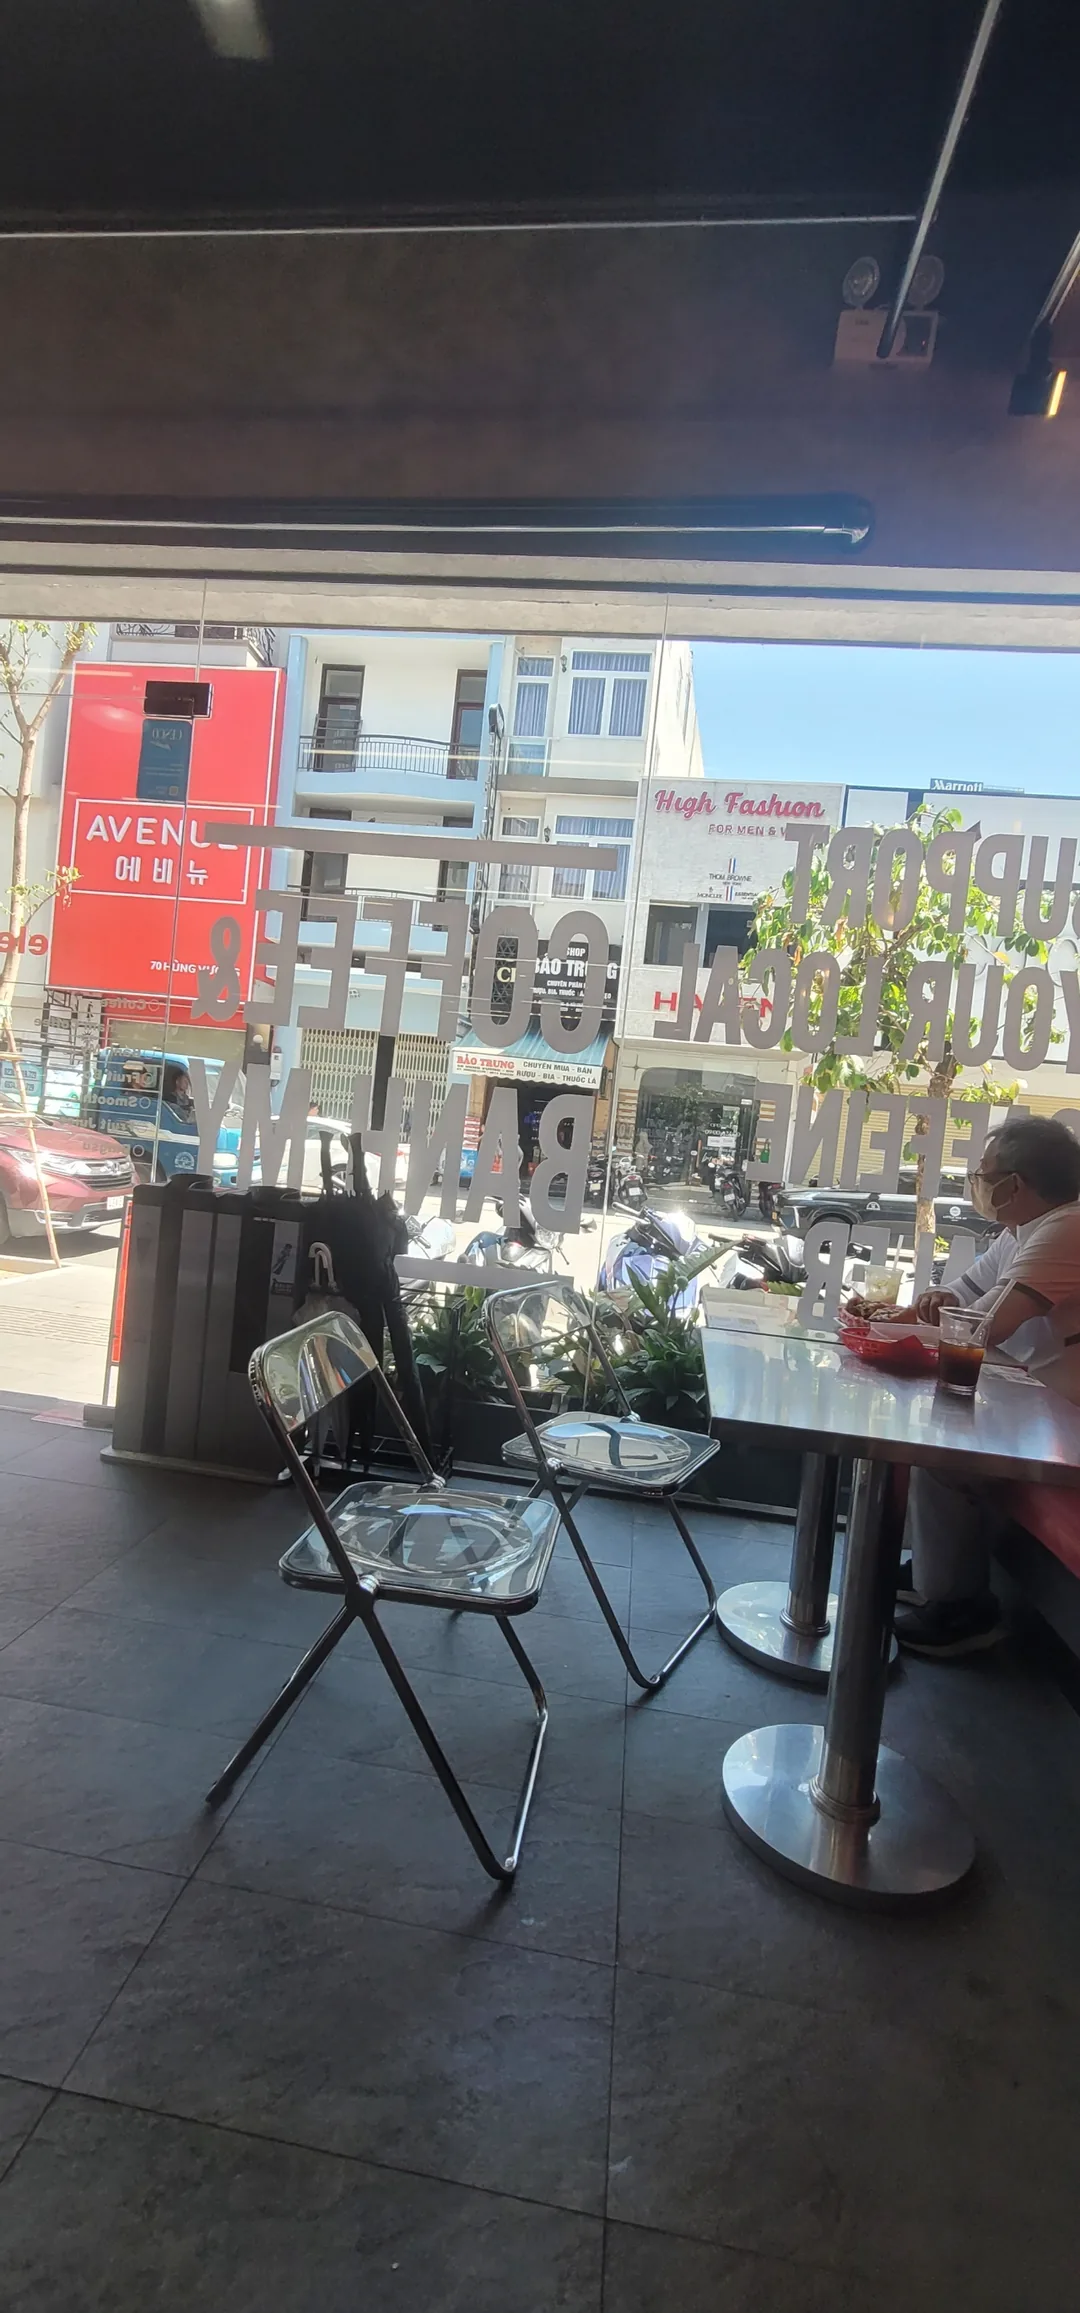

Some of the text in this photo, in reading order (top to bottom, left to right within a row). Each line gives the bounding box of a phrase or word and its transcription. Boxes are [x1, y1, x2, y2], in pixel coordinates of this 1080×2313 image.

[933, 780, 982, 791] Marriott
[655, 790, 825, 820] High Fashion
[86, 815, 238, 850] AVENU
[709, 824, 733, 835] FOR
[737, 826, 764, 836] MEN
[768, 826, 777, 836] &
[150, 961, 162, 970] 70
[567, 959, 618, 980] TRG
[480, 1058, 515, 1070] TRUNG
[554, 1064, 570, 1073] MUA
[543, 1072, 555, 1080] BIA
